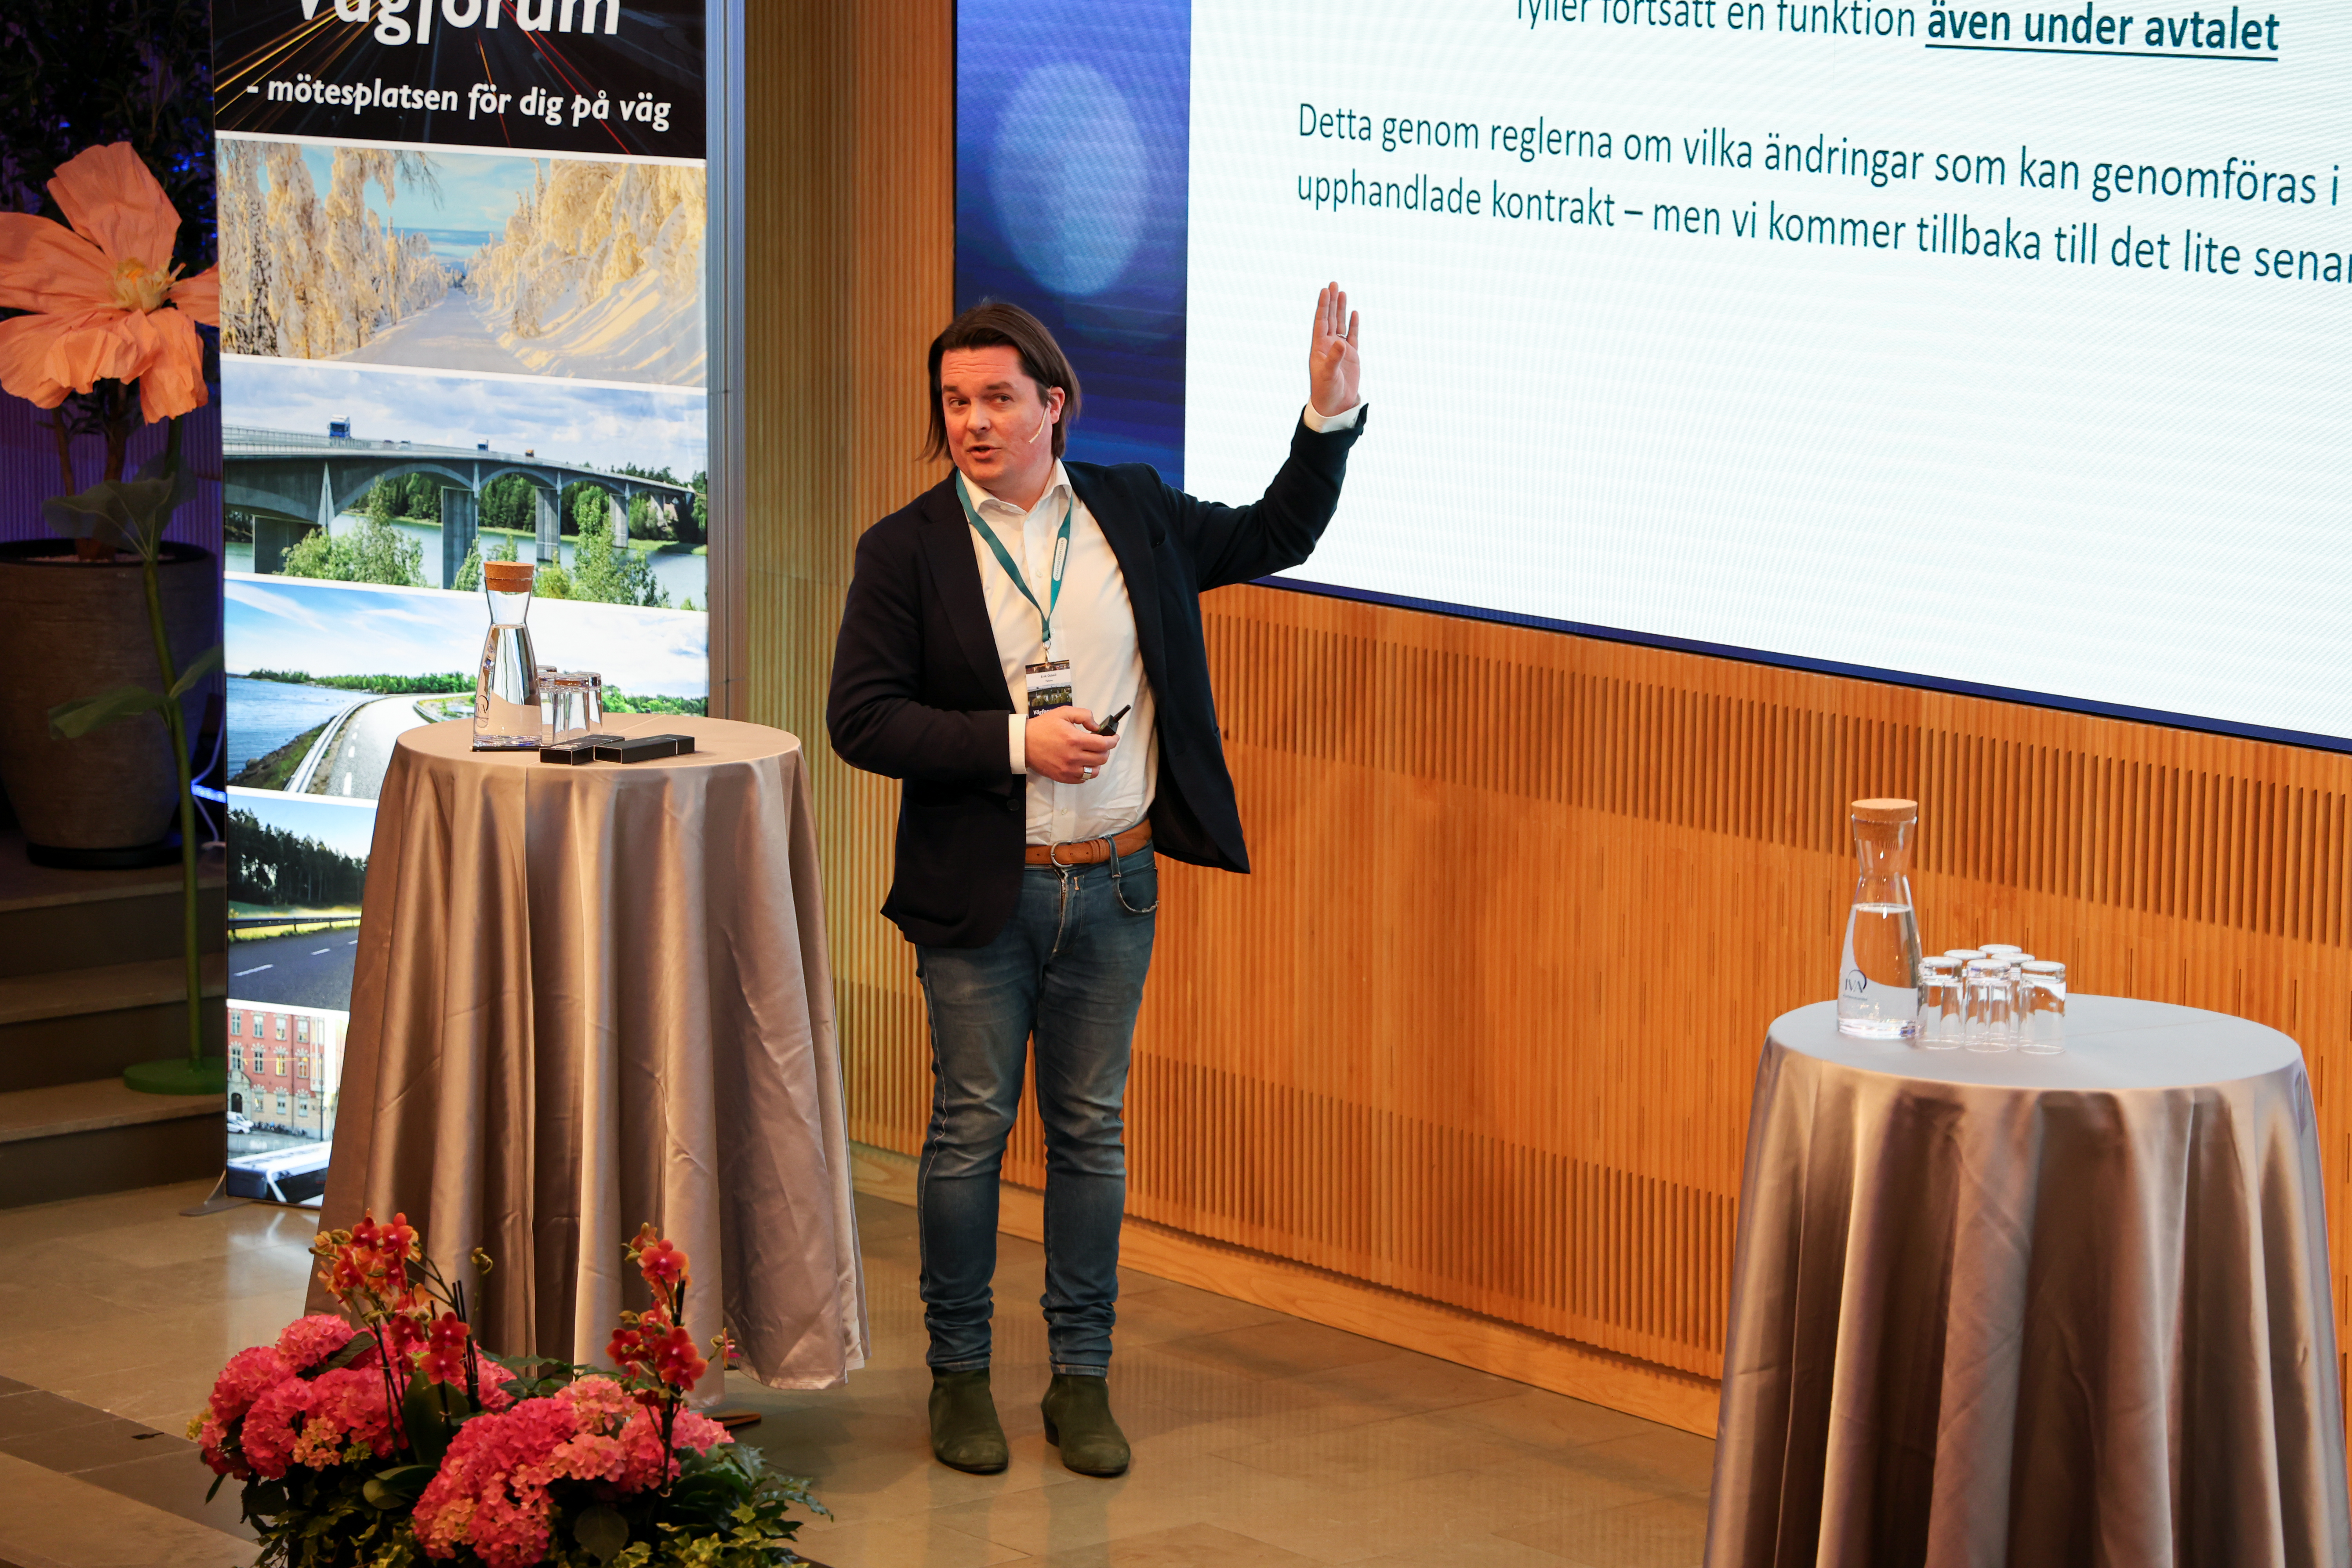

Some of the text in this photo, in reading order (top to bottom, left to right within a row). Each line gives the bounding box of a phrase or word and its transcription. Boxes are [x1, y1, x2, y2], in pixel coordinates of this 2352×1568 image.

[1602, 0, 1716, 28] fortsatt
[1728, 2, 1764, 31] en
[1777, 0, 1915, 37] funktion
[1928, 0, 2010, 41] även
[2025, 2, 2134, 45] under
[2145, 6, 2280, 51] avtalet
[268, 73, 458, 114] mötesplatsen
[468, 83, 512, 120] för
[519, 86, 564, 125] dig
[571, 90, 610, 127] på
[619, 92, 671, 131] väg
[1300, 103, 2339, 206] Detta genom reglerna om vilka ändringar som kan genomföras i
[1298, 168, 1481, 215] upphandlade
[1493, 180, 1615, 227] kontrakt
[1654, 204, 1720, 236] men
[1732, 201, 1757, 238] vi
[1769, 200, 1906, 249] kommer
[1916, 212, 2040, 260] tillbaka
[2054, 222, 2097, 265] till
[2111, 225, 2171, 270] det
[2184, 229, 2240, 275] lite
